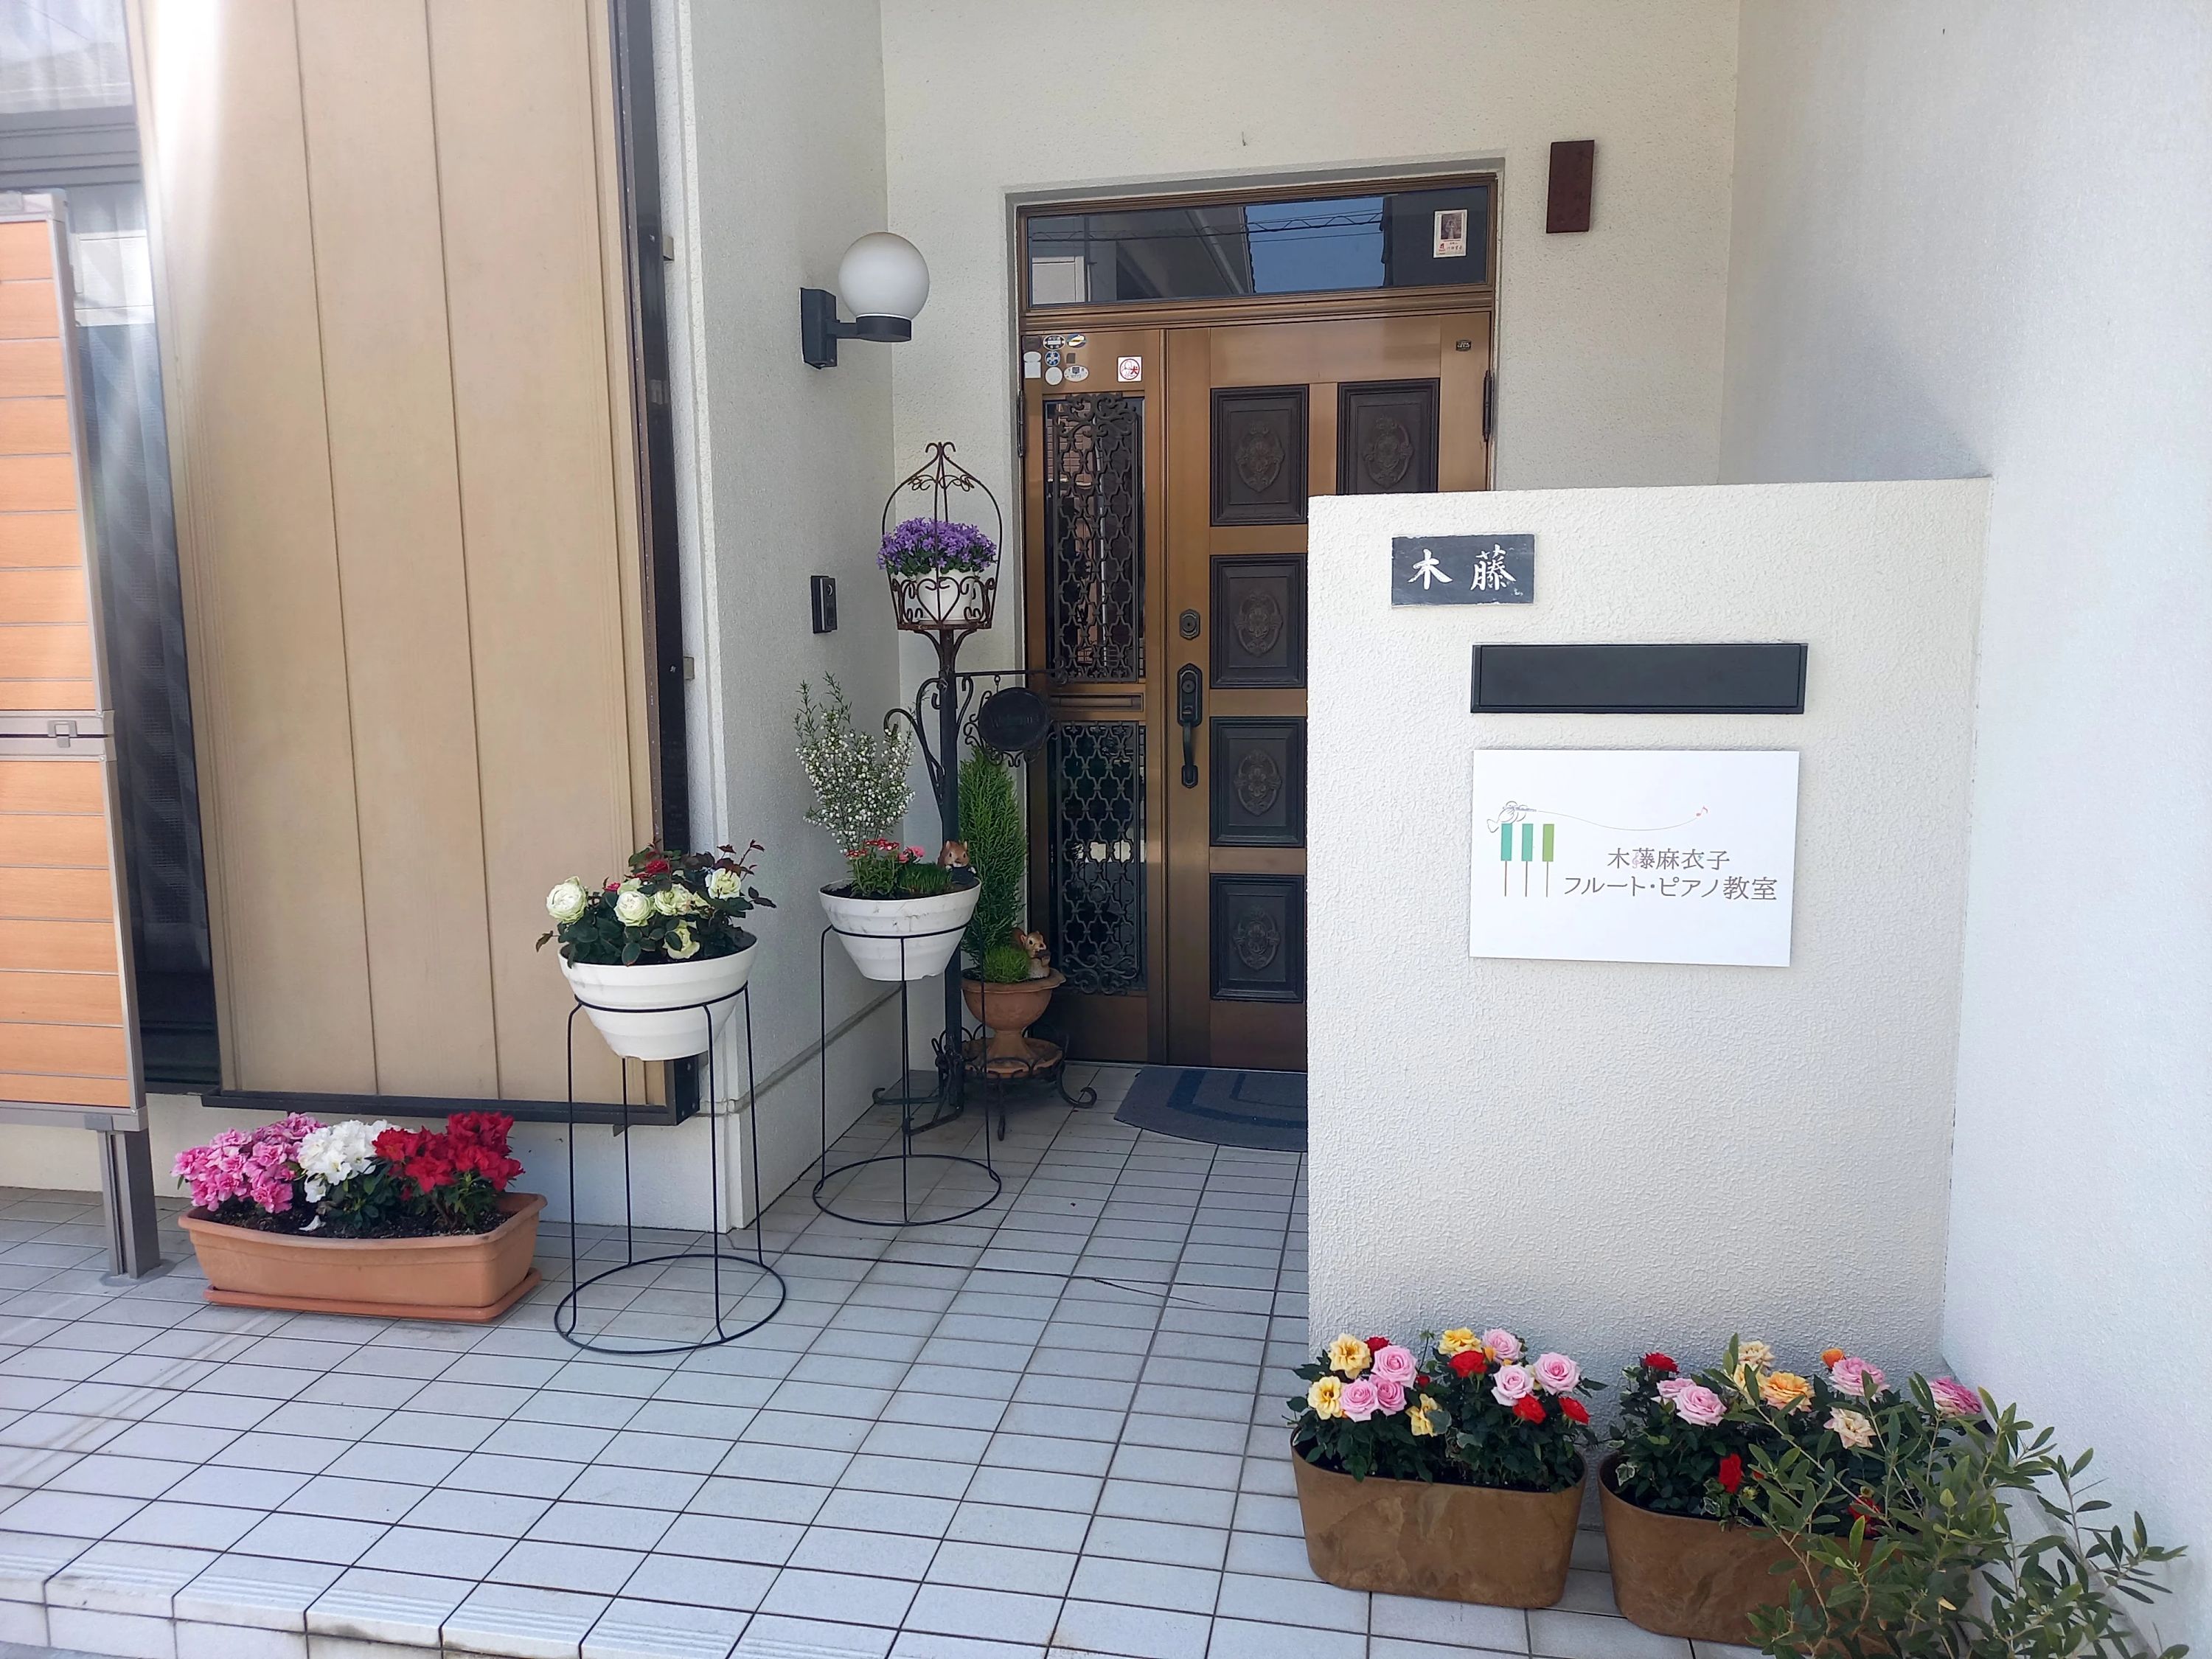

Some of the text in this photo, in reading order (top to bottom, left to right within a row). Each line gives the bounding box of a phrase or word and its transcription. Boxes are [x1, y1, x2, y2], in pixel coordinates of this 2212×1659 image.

[1408, 543, 1517, 591] 木藤
[1607, 848, 1730, 870] 木藤麻衣子
[1565, 876, 1778, 900] フルート・ピアノ教室
